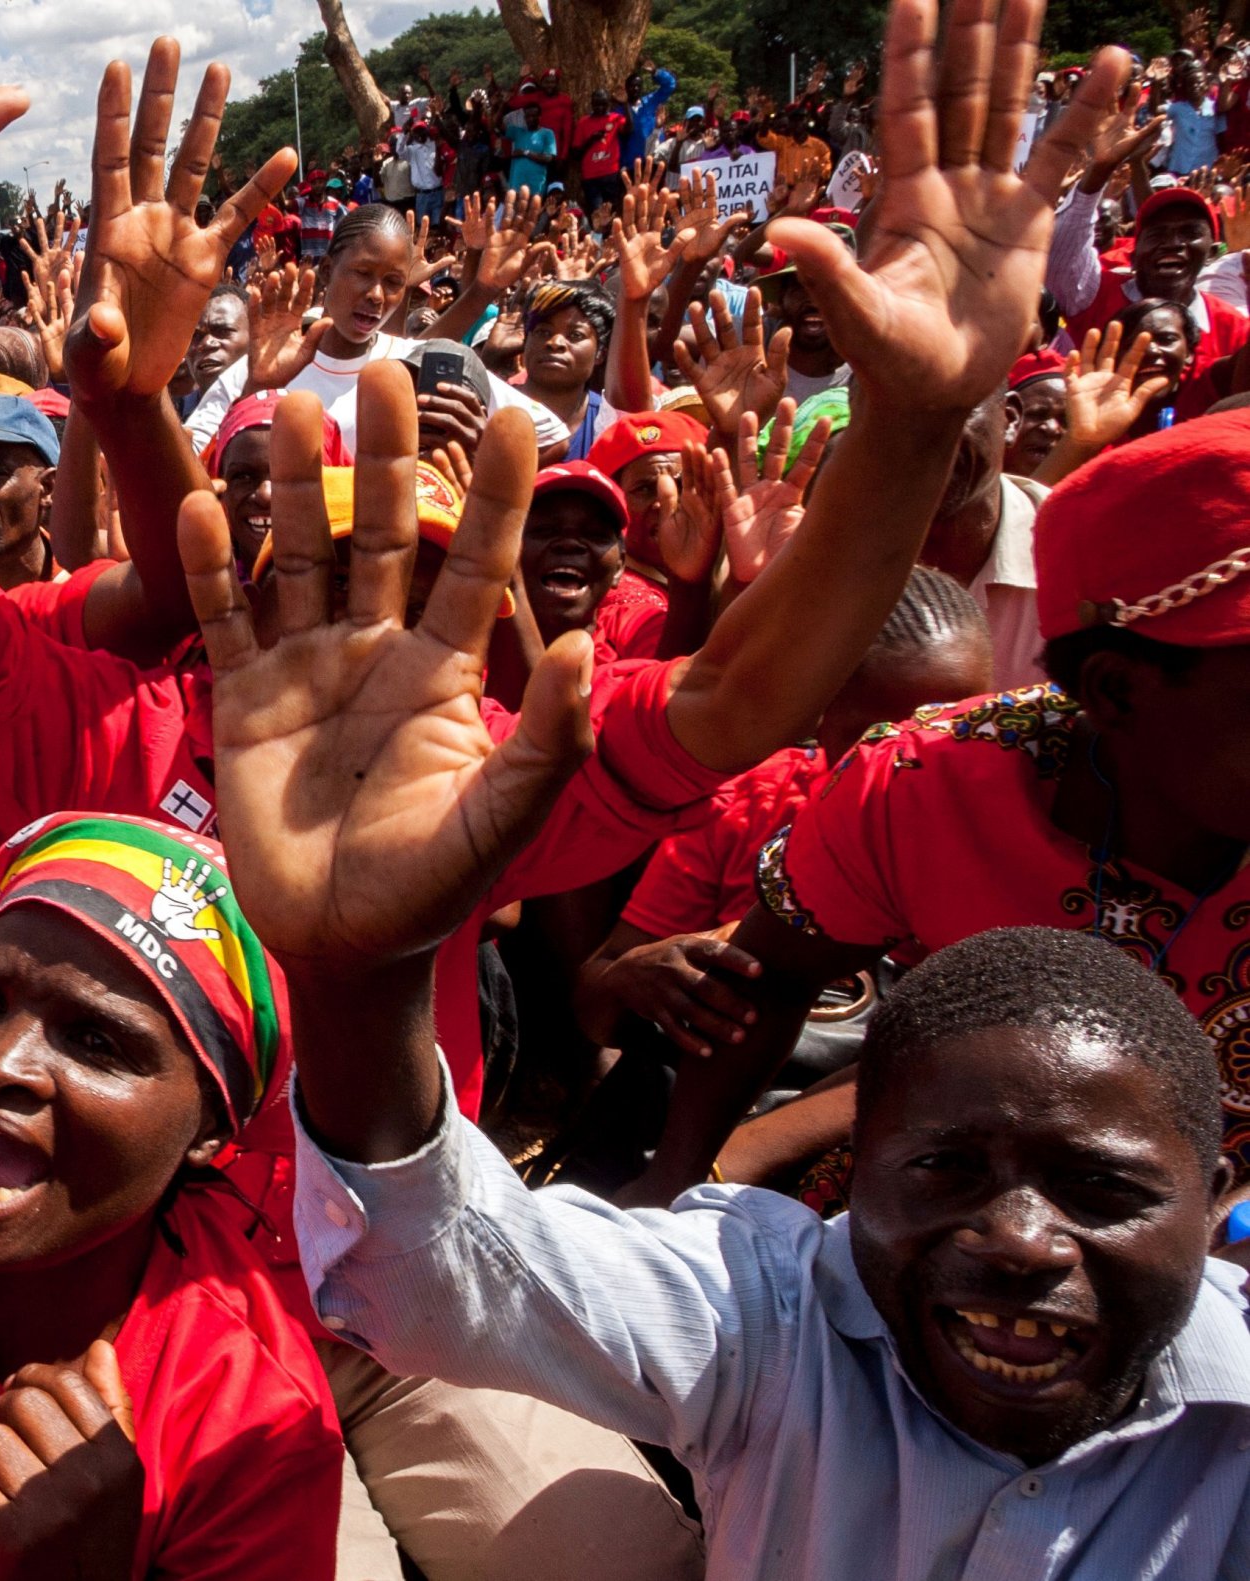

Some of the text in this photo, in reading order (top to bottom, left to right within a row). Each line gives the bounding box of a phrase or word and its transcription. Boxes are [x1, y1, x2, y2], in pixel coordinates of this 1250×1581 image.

[702, 162, 758, 181] O ITAI
[717, 180, 770, 199] MARA
[114, 913, 178, 979] MDC
